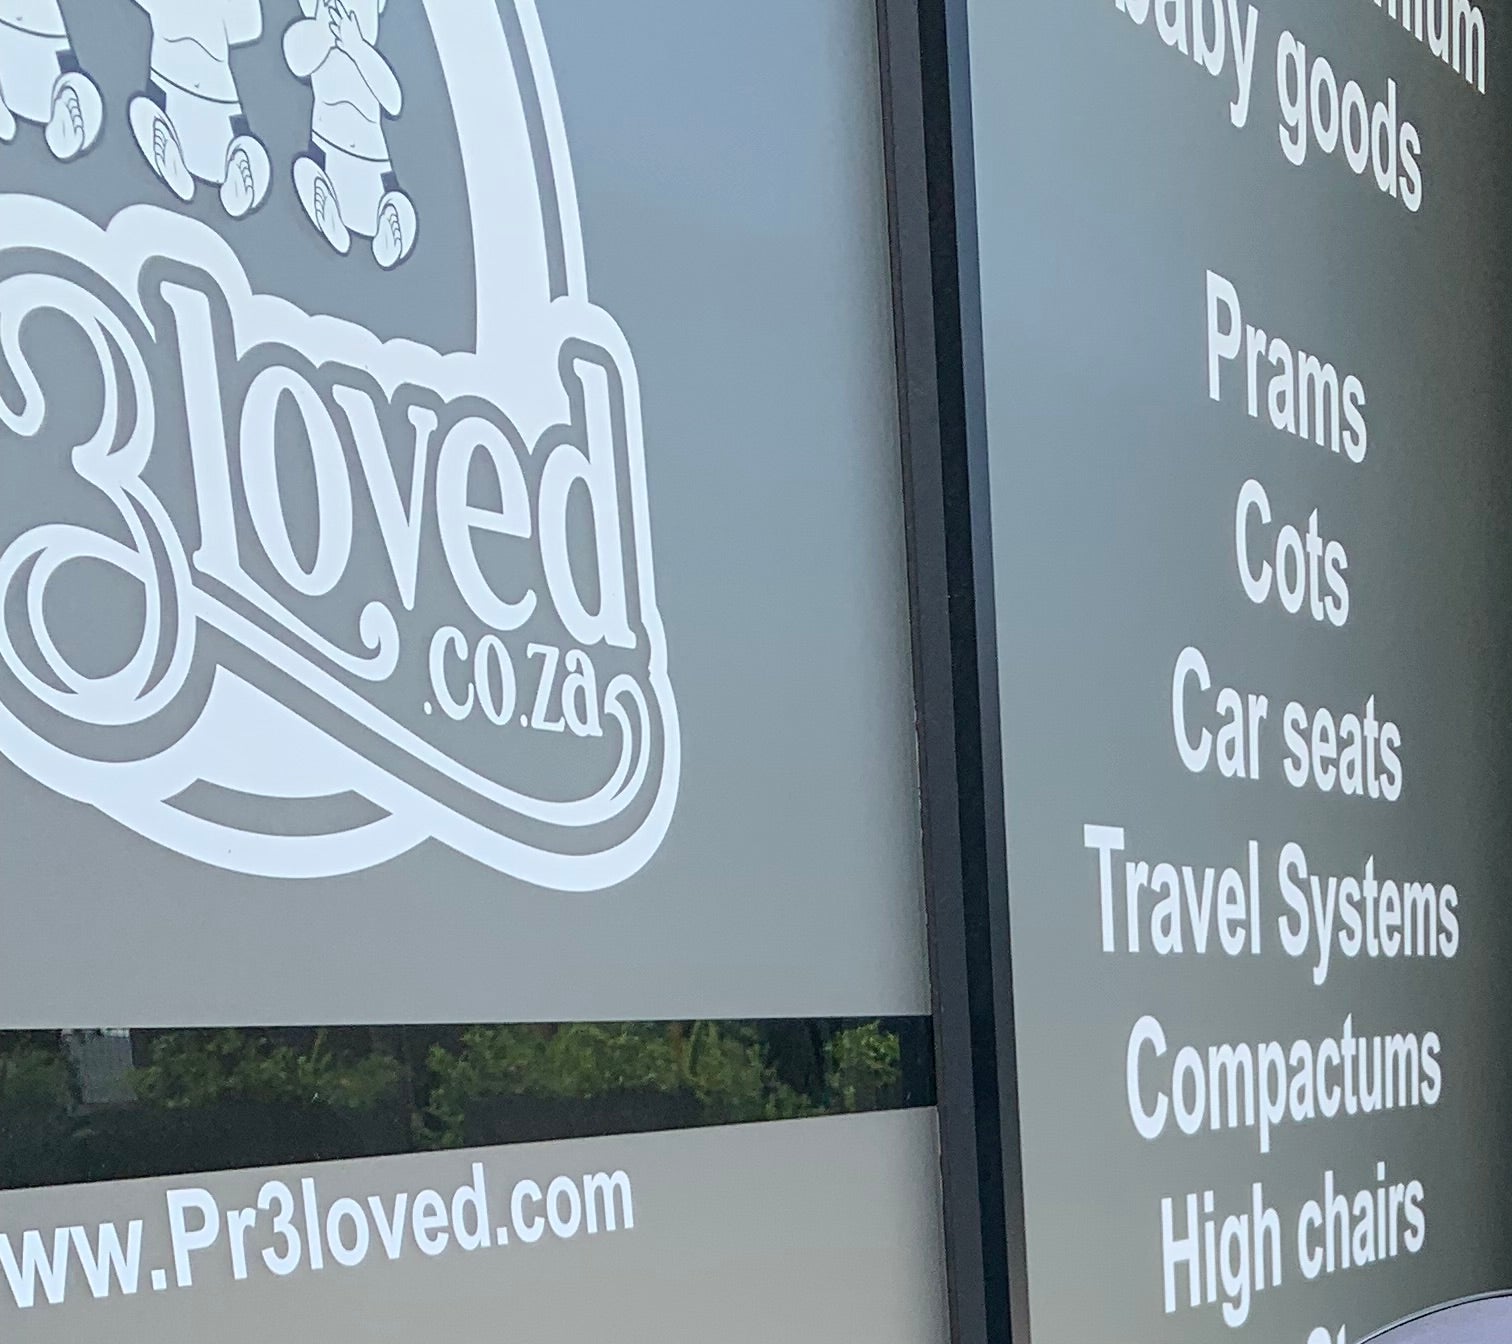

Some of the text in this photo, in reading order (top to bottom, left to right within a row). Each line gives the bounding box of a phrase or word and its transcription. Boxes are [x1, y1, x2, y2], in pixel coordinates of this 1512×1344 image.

[1115, 0, 1422, 211] aby goods
[1207, 270, 1367, 463] Prams
[1236, 479, 1349, 626] Cots
[1173, 647, 1402, 801] Car seats
[1084, 824, 1459, 985] Travel Systems
[1127, 1014, 1441, 1153] Compactums
[1162, 1162, 1424, 1327] High chairs
